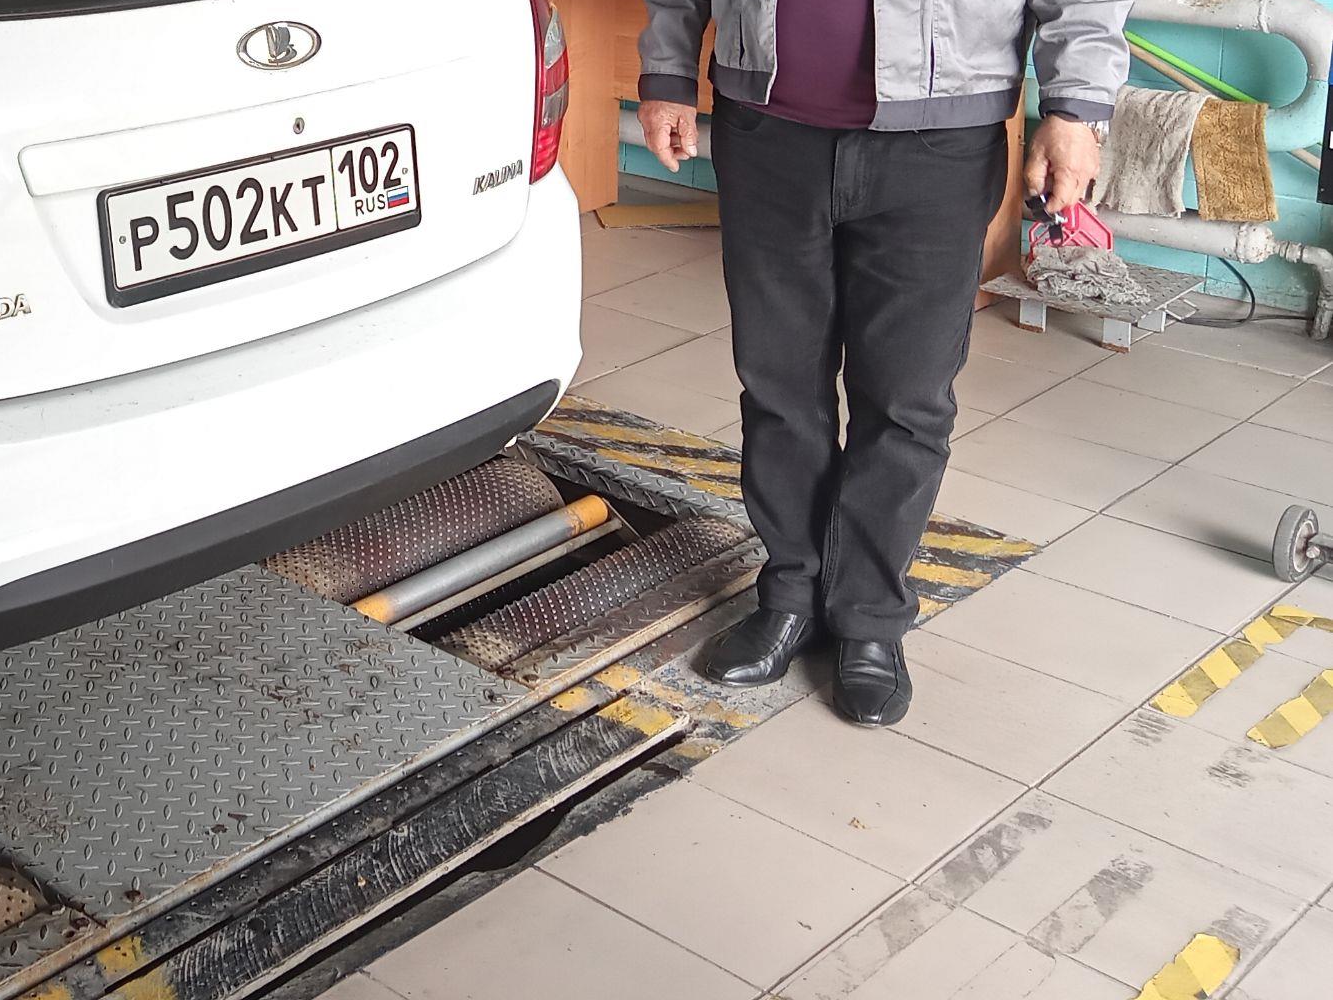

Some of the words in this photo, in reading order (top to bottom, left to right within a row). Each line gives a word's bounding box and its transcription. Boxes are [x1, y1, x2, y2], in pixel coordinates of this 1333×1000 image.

[336, 141, 402, 198] 102
[471, 159, 524, 196] KALINA
[354, 193, 387, 217] RUS
